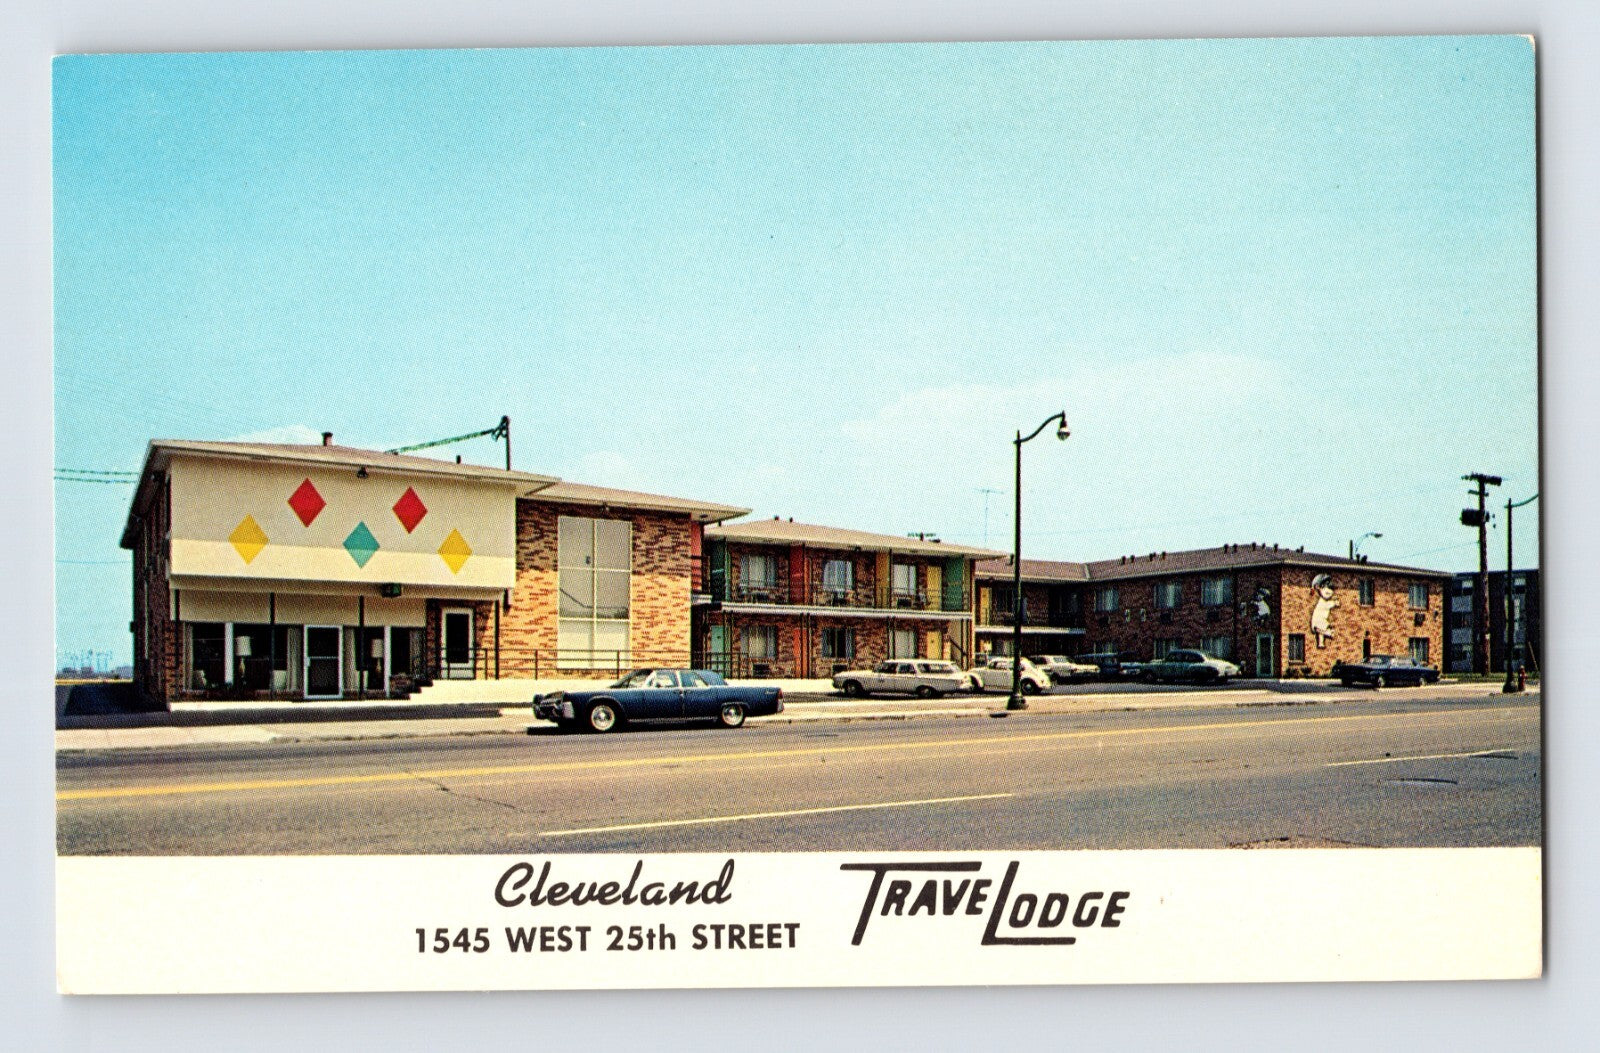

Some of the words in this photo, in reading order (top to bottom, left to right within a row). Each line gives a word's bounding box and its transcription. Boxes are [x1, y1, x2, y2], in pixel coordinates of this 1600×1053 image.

[494, 858, 735, 908] Cleveland
[415, 927, 490, 954] 1545
[504, 925, 592, 953] WEST
[606, 923, 676, 951] 25th
[691, 922, 801, 950] STREET
